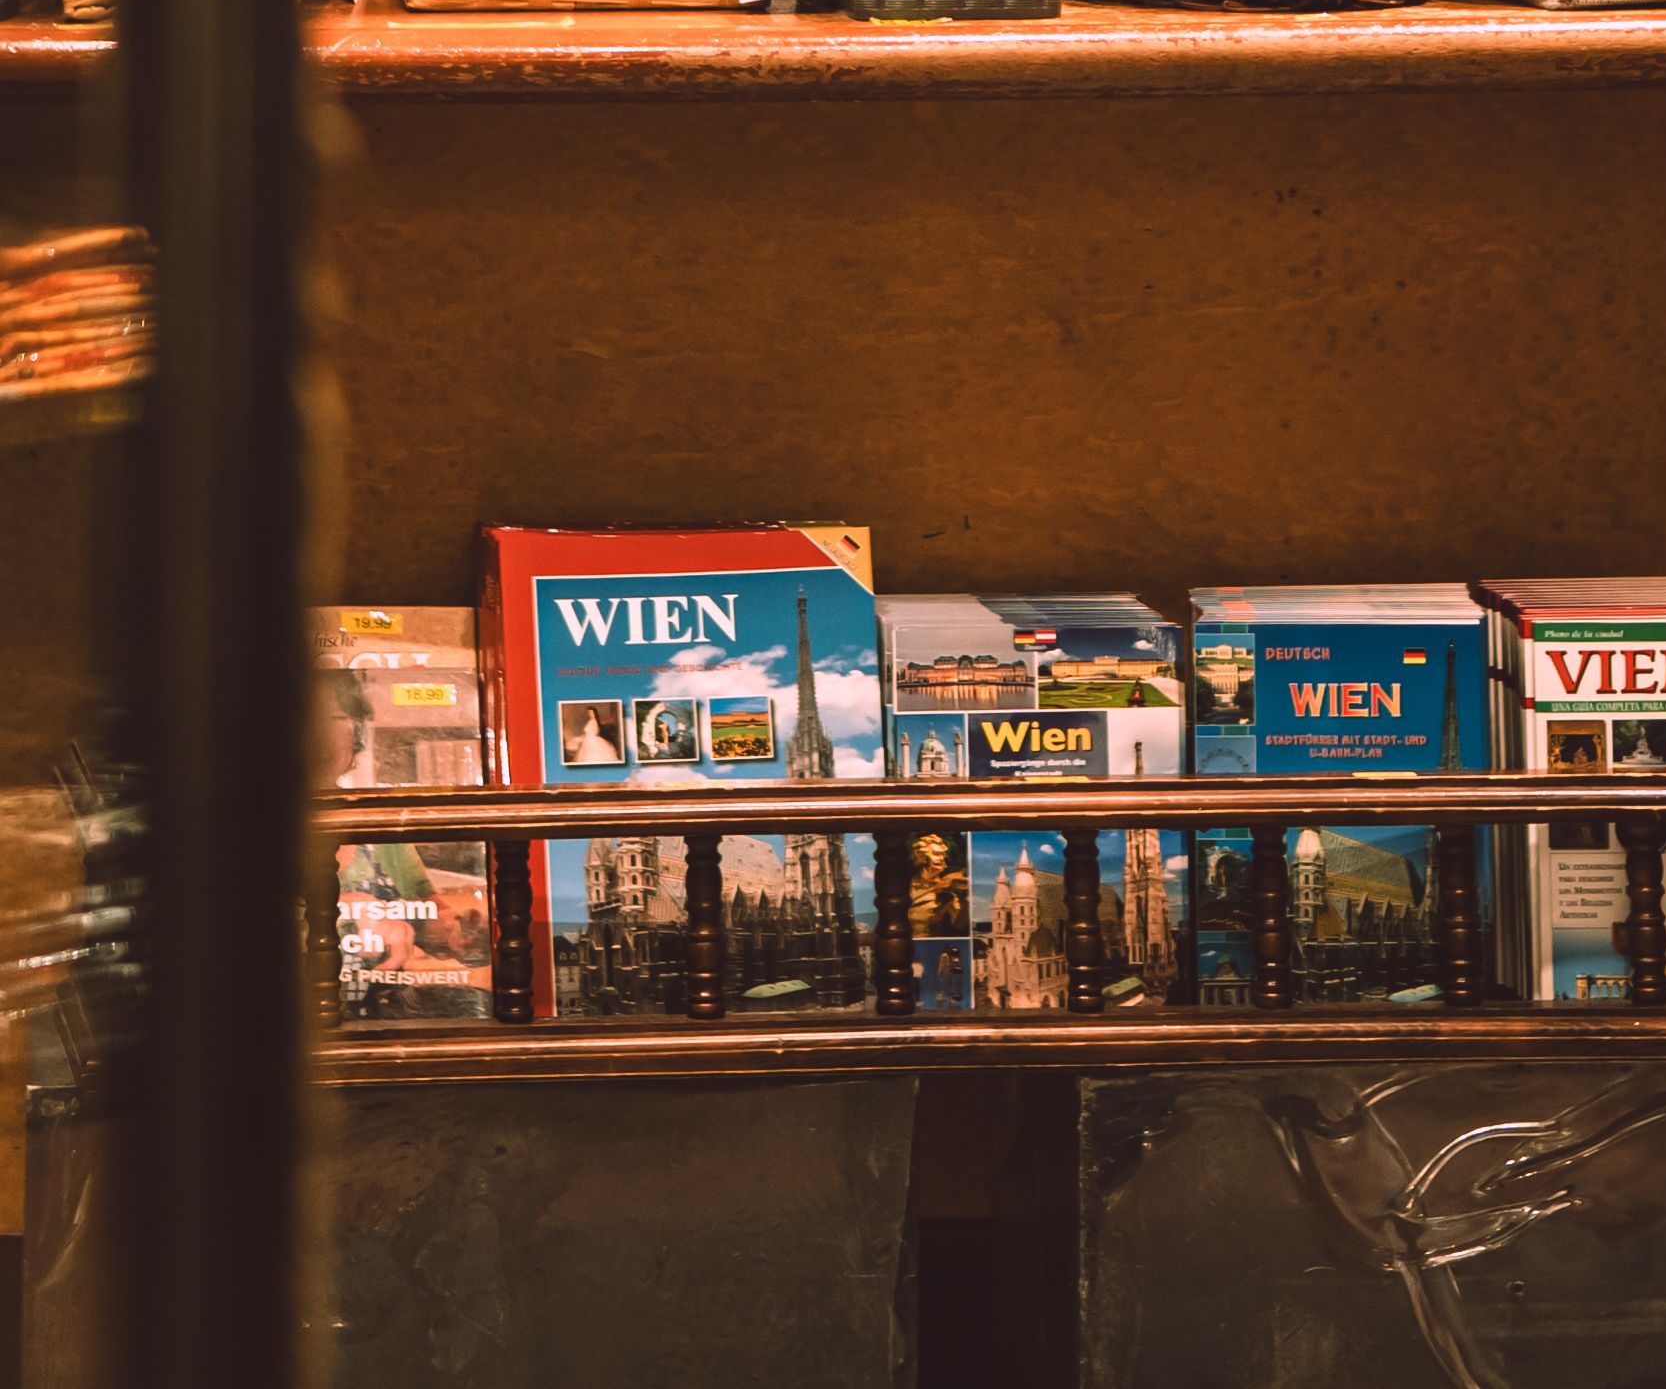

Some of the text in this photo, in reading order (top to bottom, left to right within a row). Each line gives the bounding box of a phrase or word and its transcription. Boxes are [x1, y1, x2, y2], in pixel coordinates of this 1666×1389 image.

[553, 594, 739, 647] WIEN
[1265, 647, 1331, 661] DEUTSCH
[1289, 682, 1403, 718] WIEN
[981, 721, 1093, 753] Wien
[357, 969, 471, 985] PREISWERT
